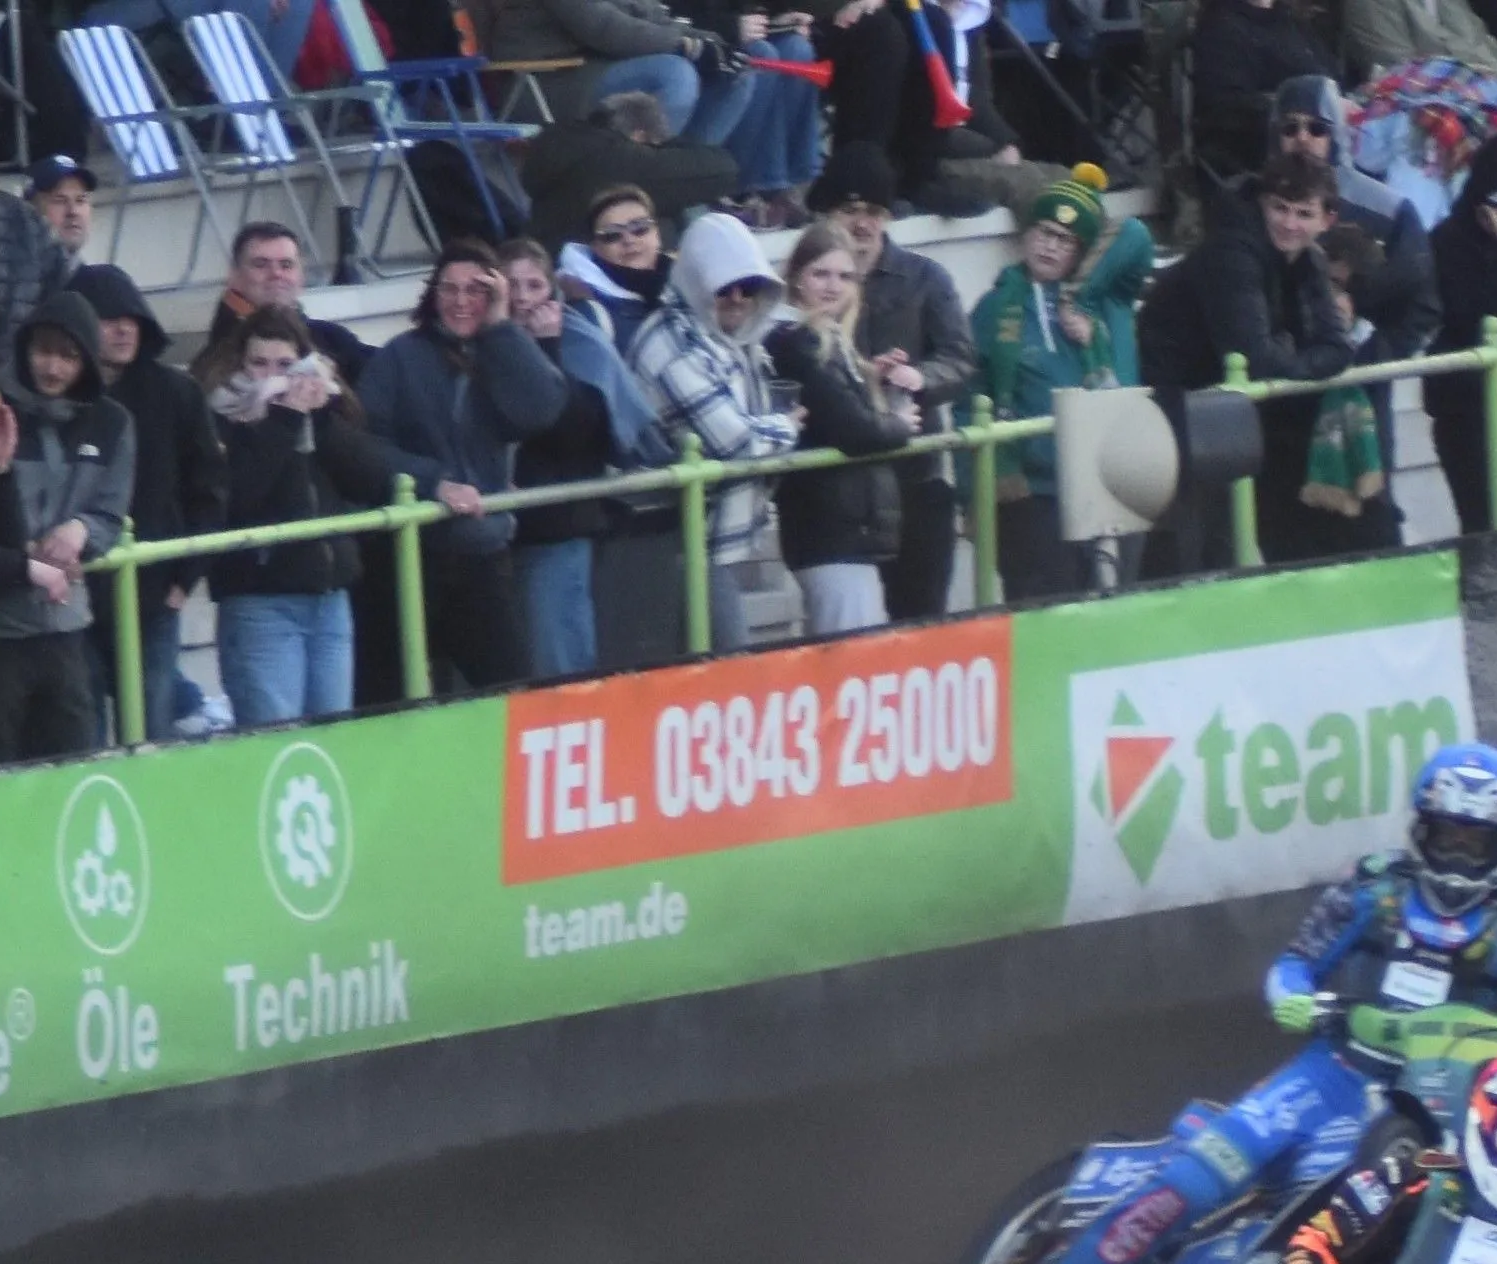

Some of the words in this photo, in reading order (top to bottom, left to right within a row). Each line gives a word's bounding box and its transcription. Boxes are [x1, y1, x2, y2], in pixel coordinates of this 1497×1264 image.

[522, 718, 634, 840] TEL.
[655, 685, 820, 819] 03843
[836, 656, 999, 788] 25000
[1194, 694, 1459, 840] team
[524, 881, 689, 959] team.de
[76, 967, 160, 1080] Öle
[225, 940, 410, 1051] Technik
